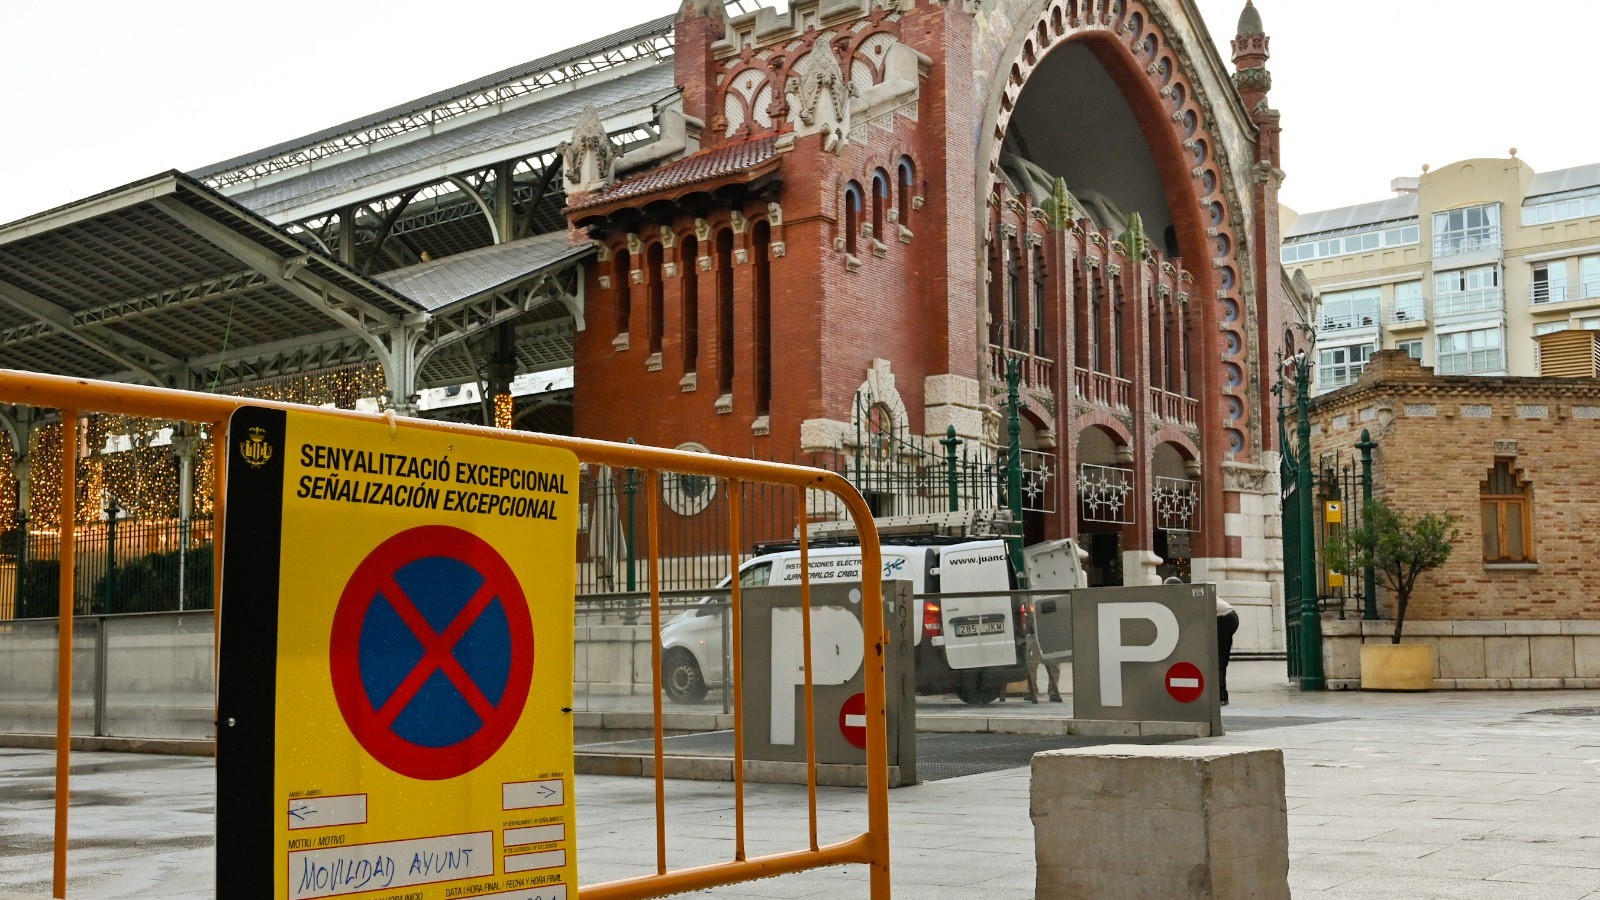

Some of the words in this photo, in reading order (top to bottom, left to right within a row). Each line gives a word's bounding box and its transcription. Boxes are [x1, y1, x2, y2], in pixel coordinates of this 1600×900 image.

[300, 443, 450, 482] SENYALITZACIÓ
[455, 462, 569, 495] EXCEPCIONAL
[296, 473, 440, 510] SEÑALIZACIÓN
[443, 490, 558, 521] EXCEPCIONAL
[784, 573, 802, 581] JUAN
[785, 561, 834, 570] INSTACIONES
[836, 557, 863, 567] ELÉCTR
[960, 624, 981, 634] 285
[1097, 602, 1180, 707] P
[769, 605, 864, 746] P
[288, 839, 311, 849] MOTIU
[317, 835, 345, 847] MOTIVO
[298, 855, 395, 894] MOVILIDAD
[409, 848, 474, 877] AYUNT
[445, 887, 462, 897] DATA
[466, 884, 484, 894] HORA
[484, 882, 500, 892] FINAL
[505, 878, 524, 889] FECHA
[530, 875, 546, 885] HORA
[547, 873, 561, 883] FINAL
